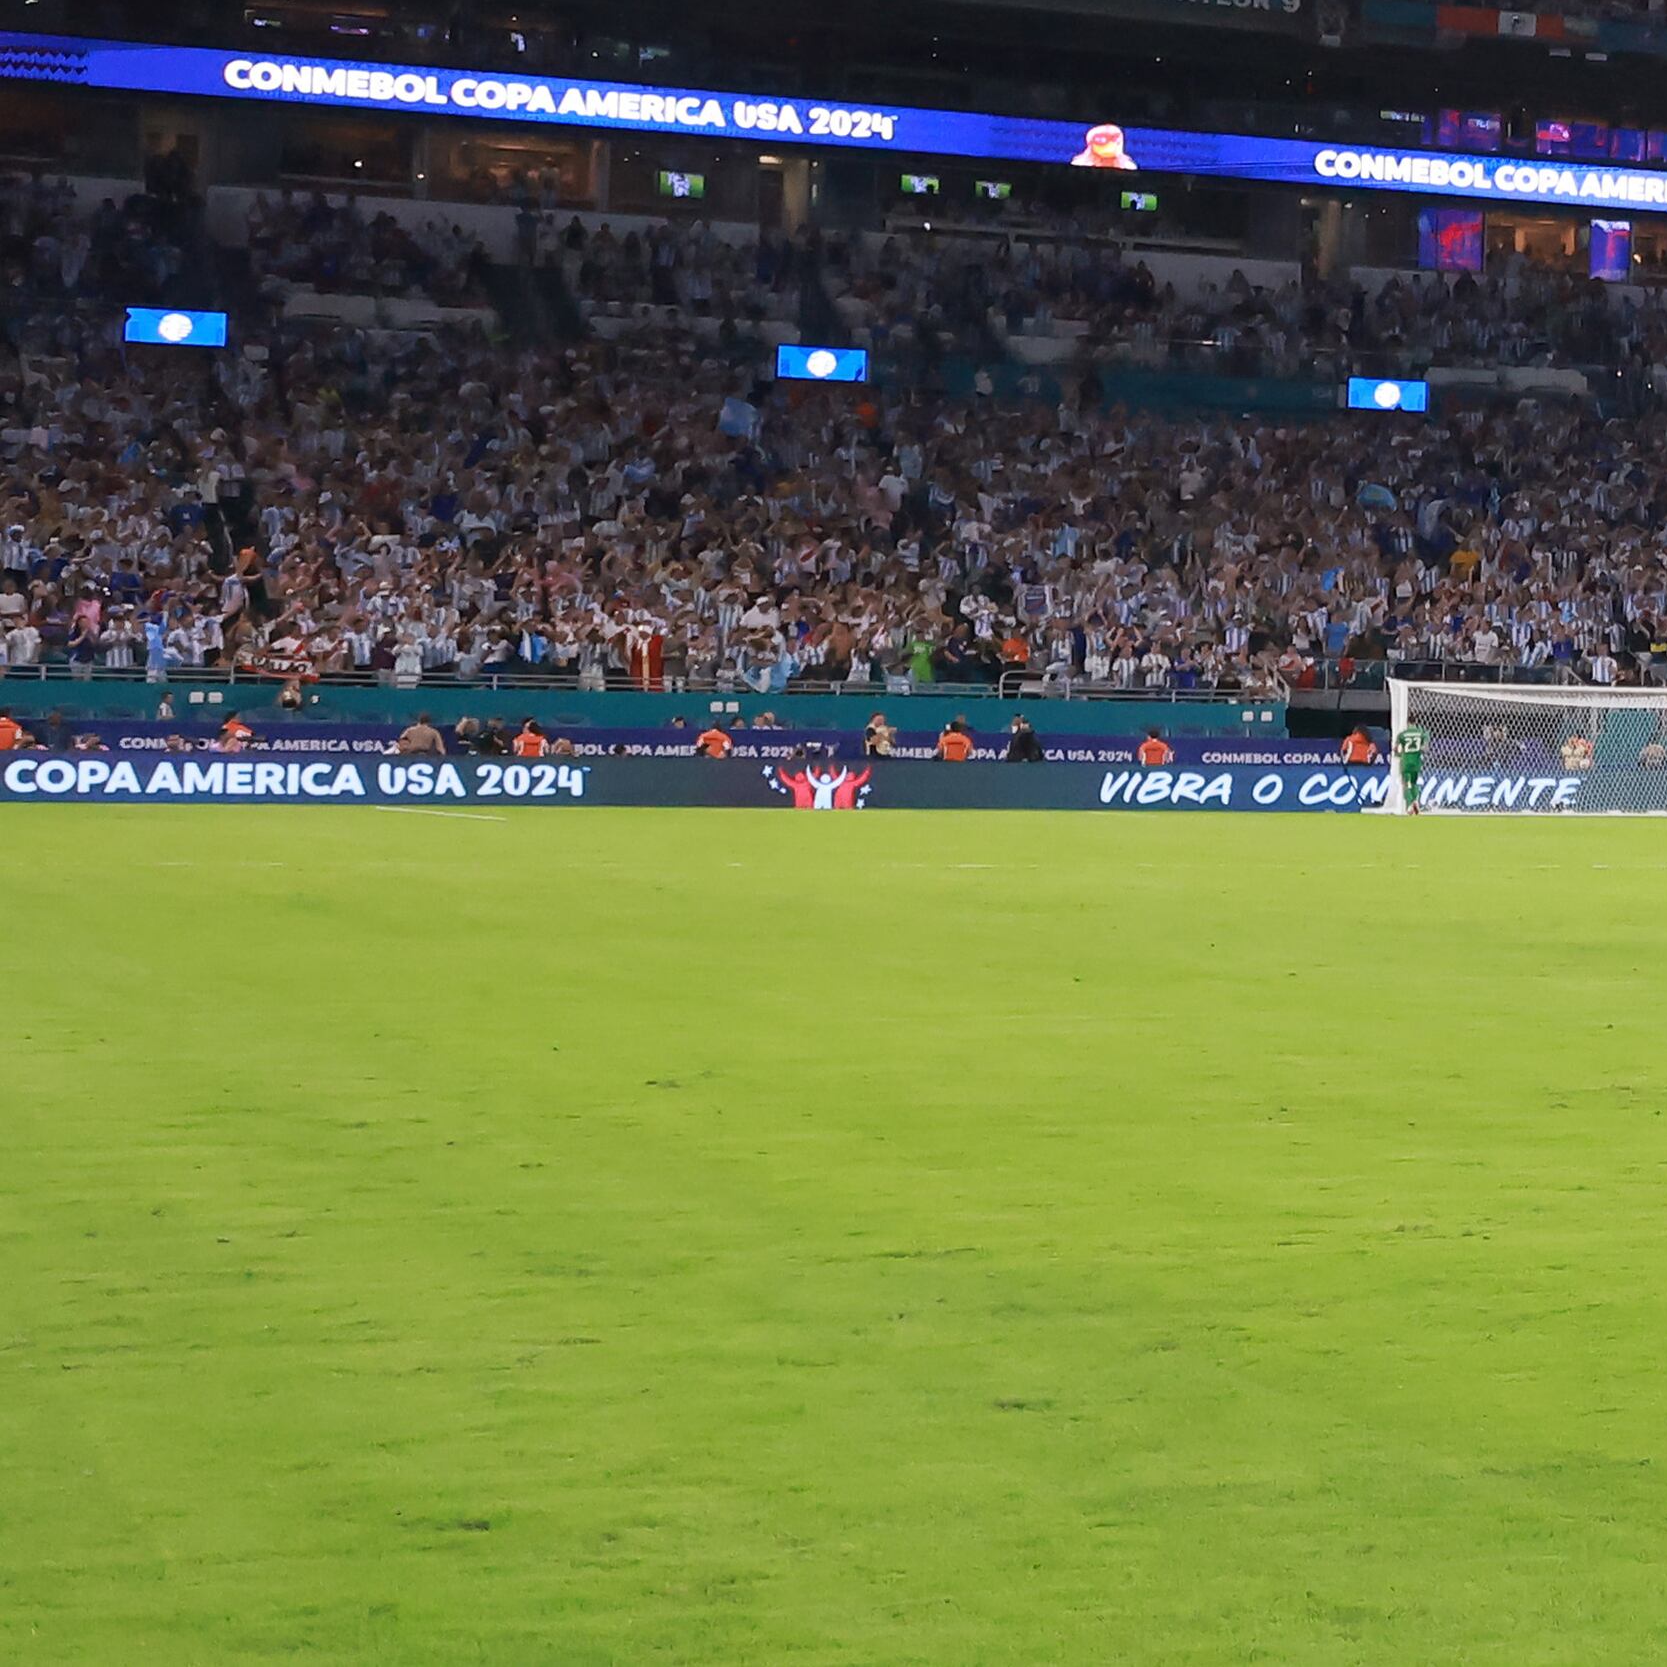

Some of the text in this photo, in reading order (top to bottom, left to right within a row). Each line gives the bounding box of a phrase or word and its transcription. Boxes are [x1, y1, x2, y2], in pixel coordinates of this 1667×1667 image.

[223, 58, 894, 141] CONMEBOL COPA AMERICA USA 2024
[1314, 150, 1493, 190] CONMEBOL
[1494, 164, 1578, 197] COPA
[271, 738, 350, 752] AMERICA
[352, 739, 384, 753] USA
[1201, 751, 1281, 765] CONMEBOL
[1283, 752, 1321, 765] COPA
[1404, 736, 1422, 754] 23
[4, 759, 585, 798] COPA AMERICA USA 2024
[1099, 770, 1233, 805] VIBRA
[1251, 772, 1284, 805] O
